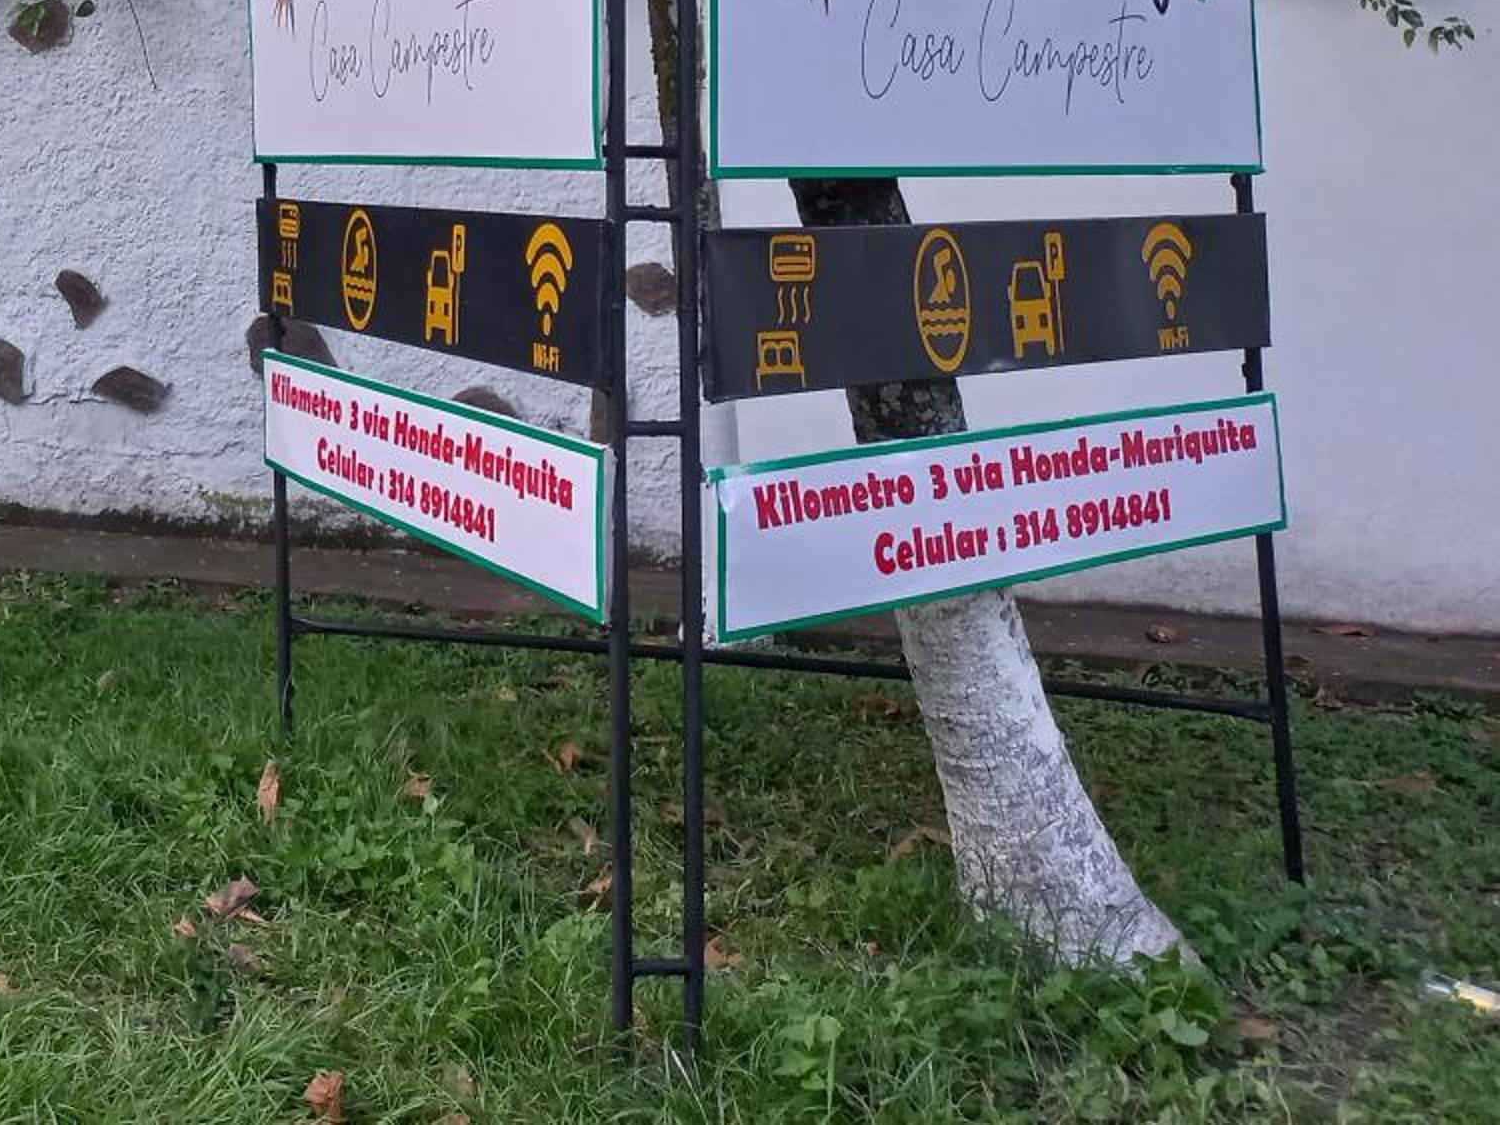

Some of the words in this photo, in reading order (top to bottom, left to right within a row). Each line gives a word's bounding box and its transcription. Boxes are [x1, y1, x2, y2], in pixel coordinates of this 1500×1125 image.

[310, 0, 362, 102] Casa
[271, 372, 342, 424] Kilometro
[349, 400, 359, 431] 3
[363, 403, 389, 442] via
[393, 410, 573, 511] Honda-Mariquita
[317, 437, 374, 490] Celular
[387, 468, 415, 507] 314
[420, 481, 495, 543] 8914841
[753, 472, 915, 530] Kilometro
[929, 464, 948, 500] 3
[953, 453, 1005, 494] via
[1009, 418, 1257, 486] Honda-Mariquita
[873, 522, 989, 575] Celular
[1013, 508, 1060, 549] 314
[1065, 488, 1171, 539] 8914841
